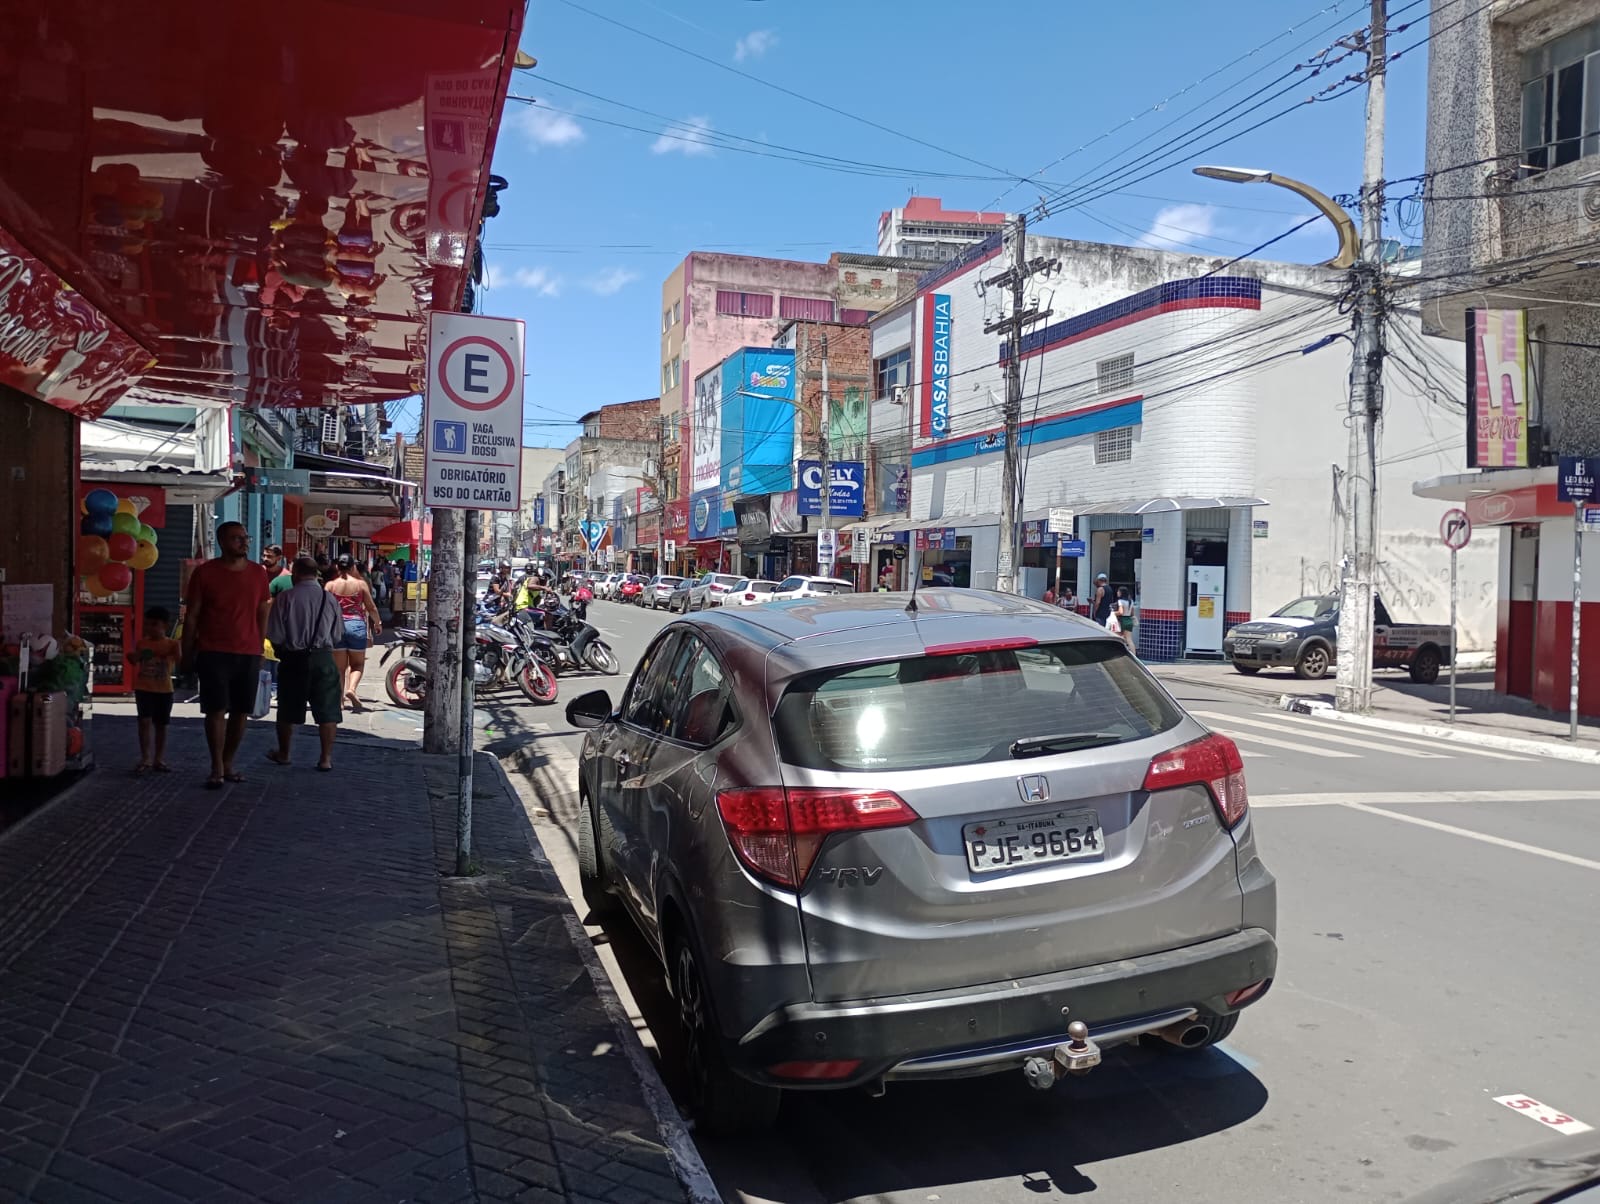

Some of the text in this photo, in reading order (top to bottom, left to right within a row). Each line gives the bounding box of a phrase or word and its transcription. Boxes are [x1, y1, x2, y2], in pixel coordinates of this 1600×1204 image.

[464, 353, 490, 394] E
[472, 422, 494, 434] VAGA
[472, 434, 515, 448] EXCLUSIVA
[472, 447, 497, 457] IDOSO
[440, 468, 506, 484] OBRIGATÓRIO
[456, 488, 470, 500] DO
